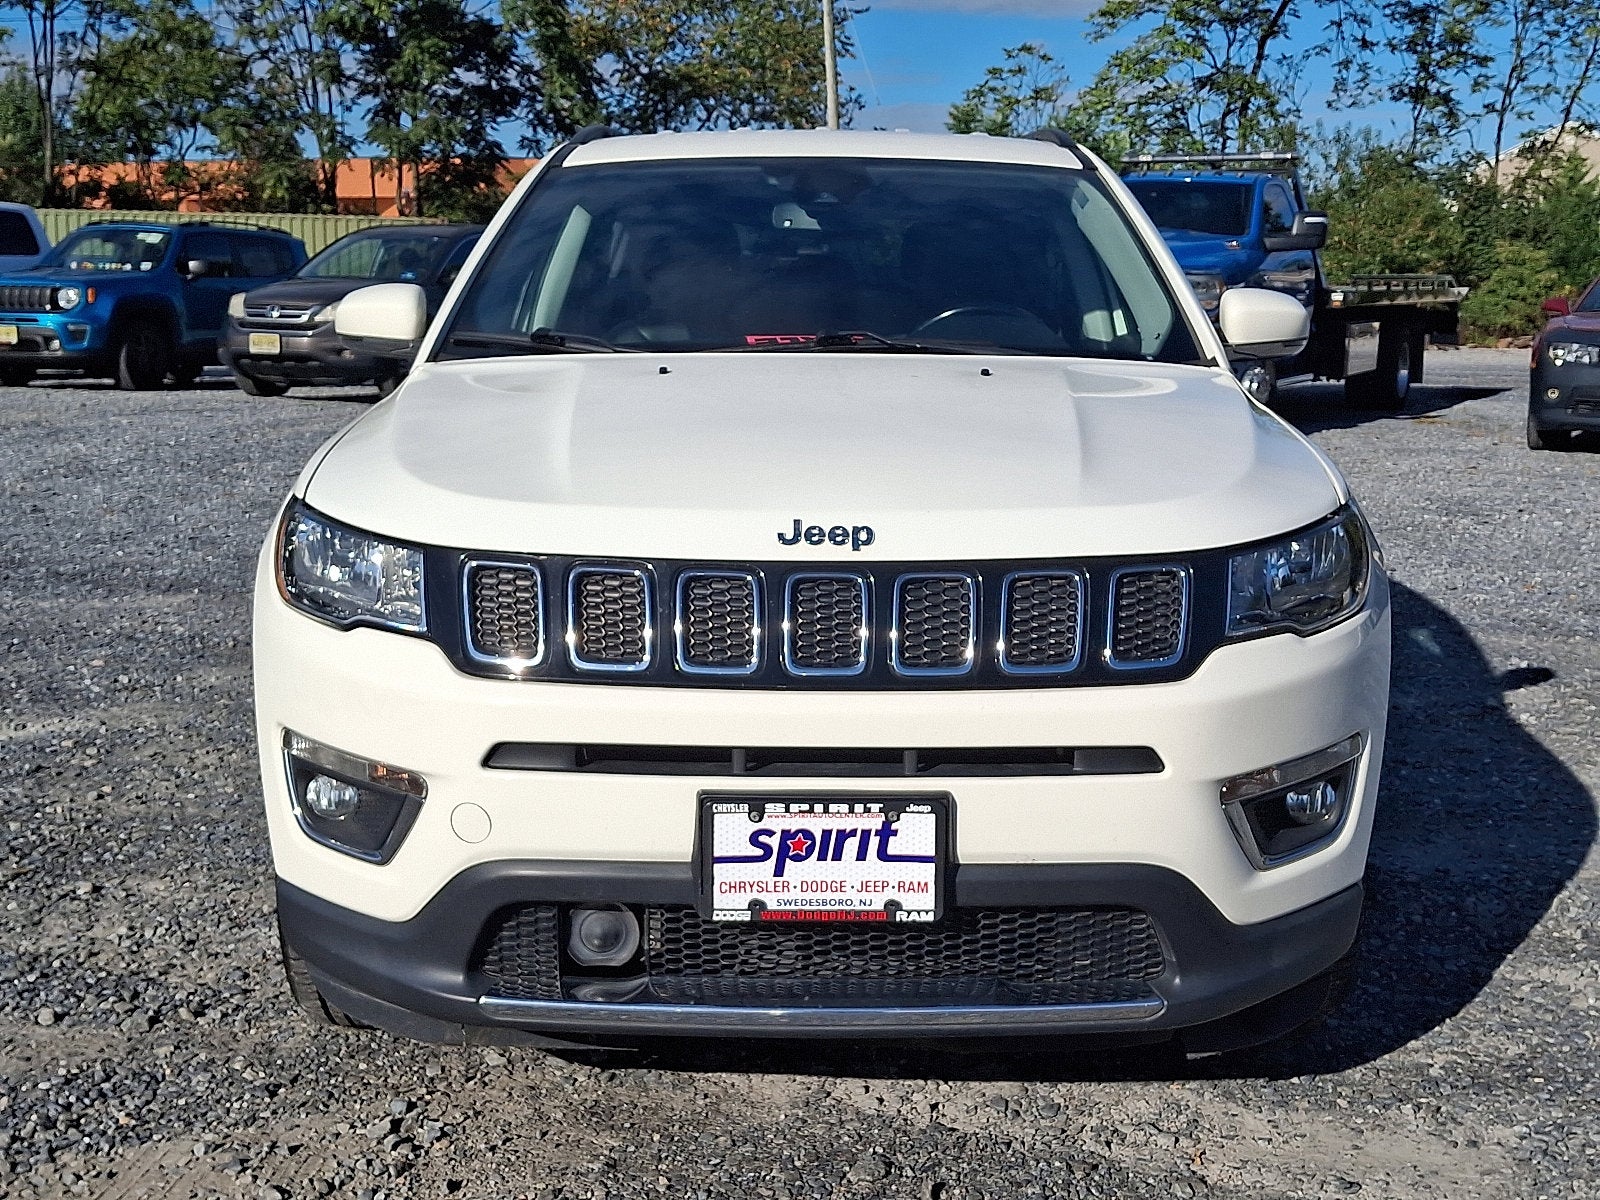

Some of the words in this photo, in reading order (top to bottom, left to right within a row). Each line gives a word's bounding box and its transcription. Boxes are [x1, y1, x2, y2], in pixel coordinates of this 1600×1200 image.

[777, 519, 875, 551] Jeep
[712, 803, 749, 813] CHRYSLER
[764, 803, 884, 813] SPIRIT
[905, 803, 932, 814] Jeep
[749, 820, 899, 877] spirit
[719, 880, 791, 894] CHRYSLER
[800, 880, 847, 894] DODGE
[856, 880, 890, 893] JEEP
[897, 880, 929, 894] RAM
[776, 898, 856, 907] SWEDESBORO,
[858, 898, 873, 907] NJ
[895, 910, 935, 922] RAM
